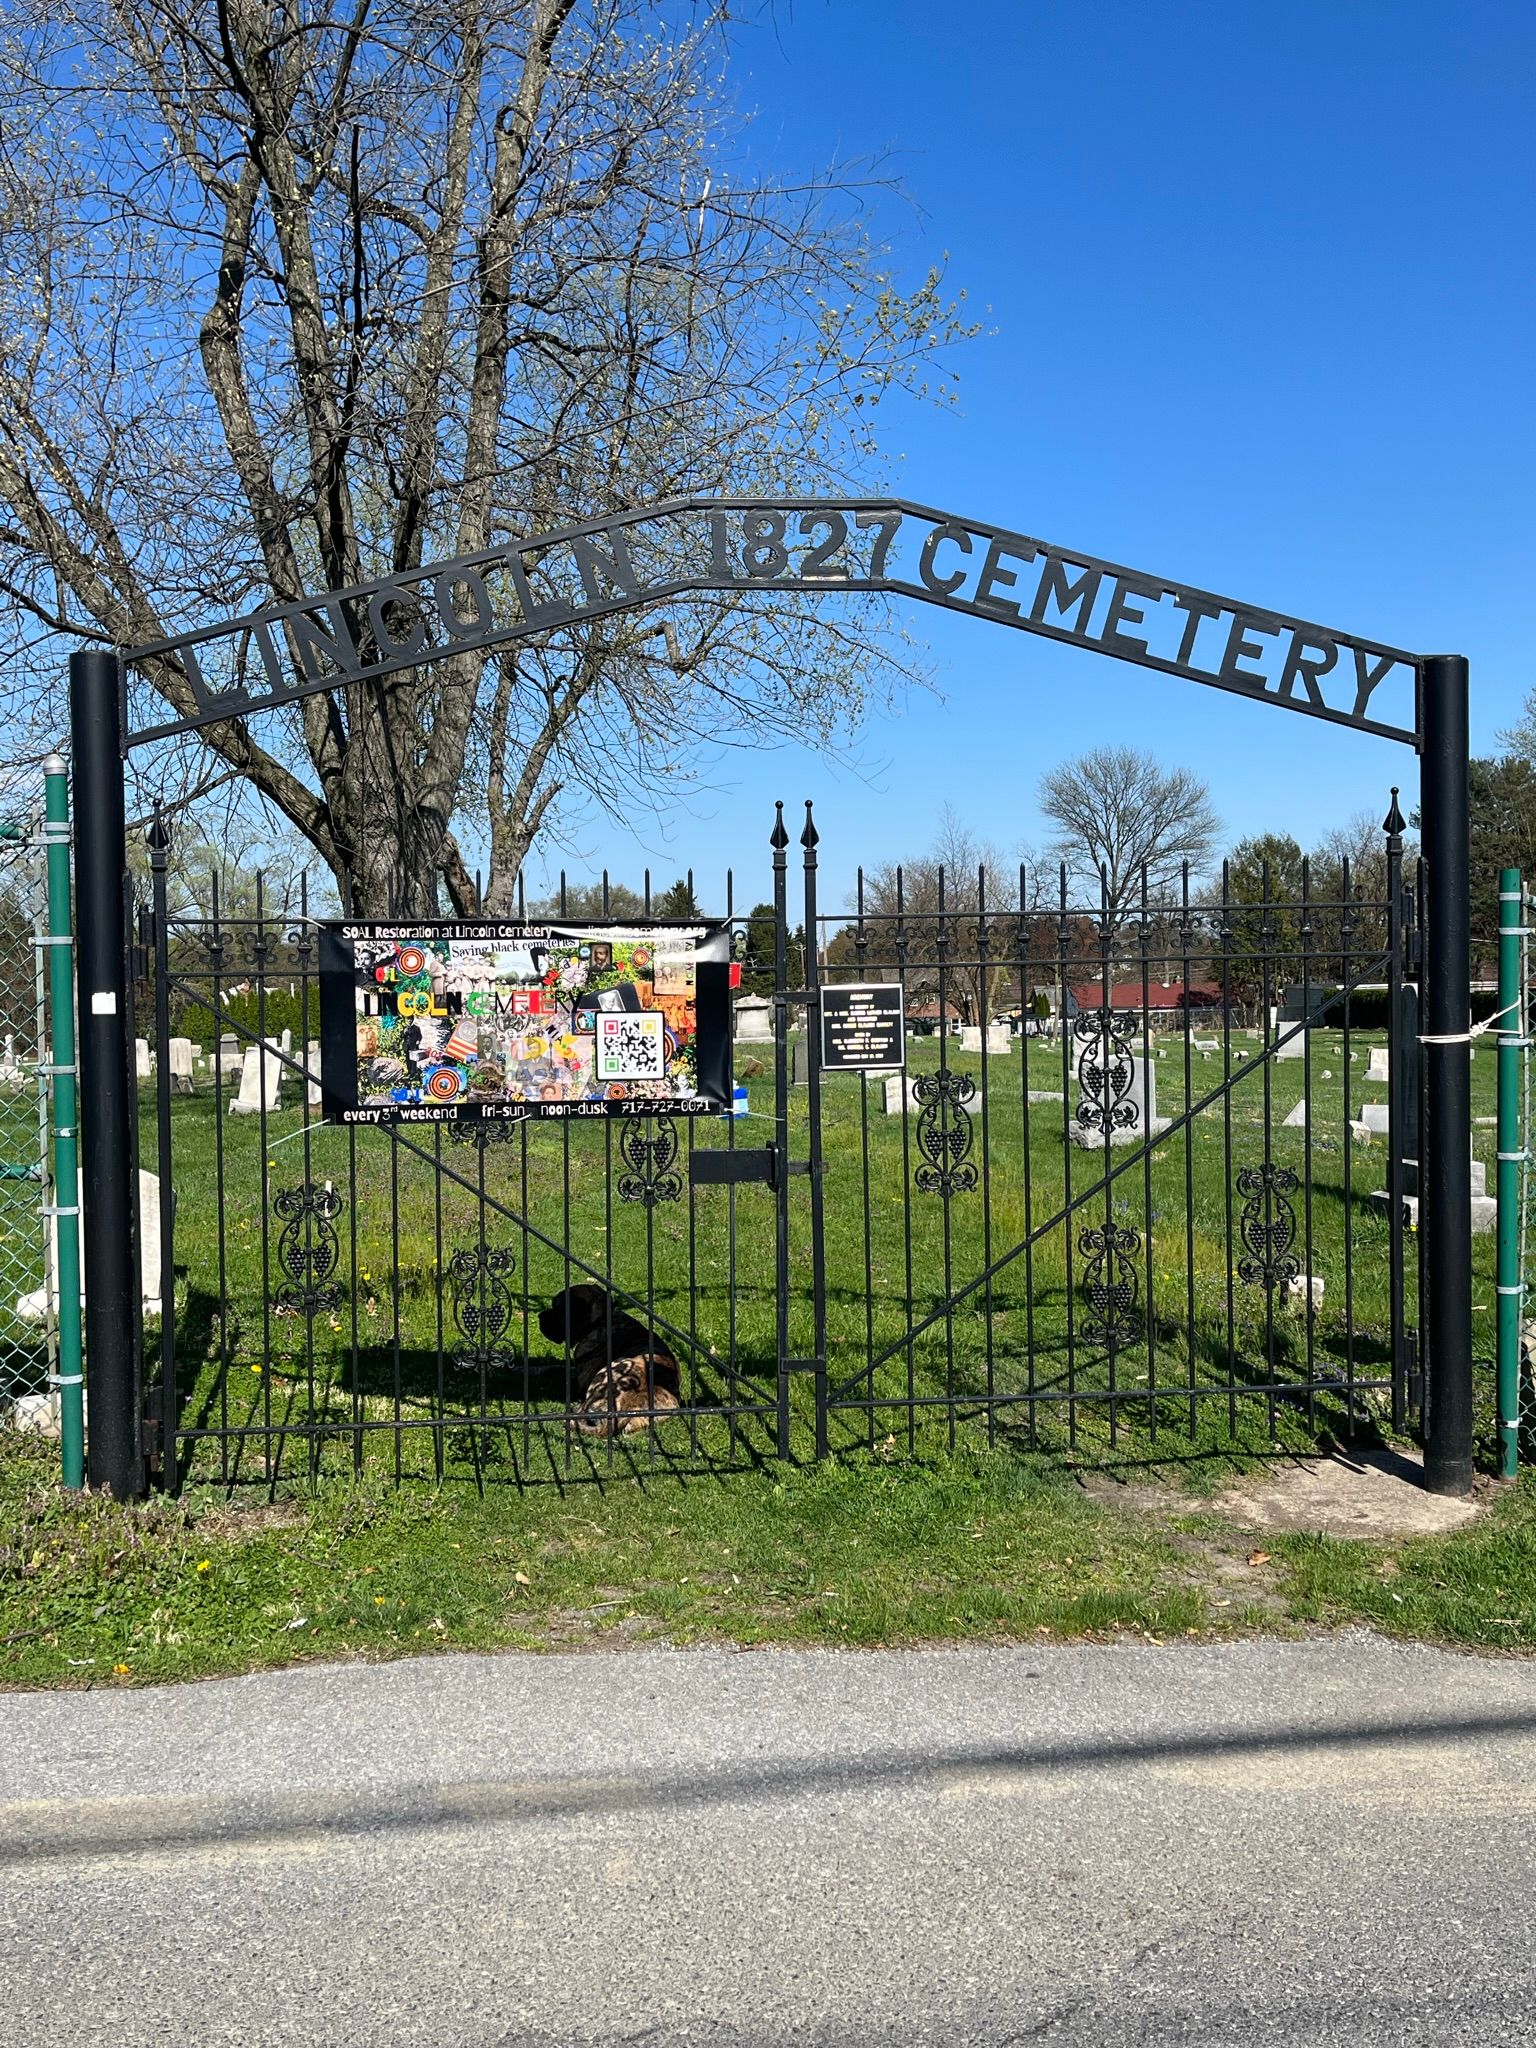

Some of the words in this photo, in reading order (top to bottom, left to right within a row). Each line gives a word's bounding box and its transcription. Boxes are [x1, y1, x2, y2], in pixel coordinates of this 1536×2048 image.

[178, 524, 641, 714] LINCOLN
[705, 505, 904, 581] 1827
[918, 523, 1396, 718] CEMETERY
[375, 925, 440, 939] Restoration
[441, 926, 453, 938] at
[455, 925, 496, 938] Lincoln
[498, 925, 552, 940] Cemetery
[451, 944, 489, 958] Saving
[491, 940, 519, 953] black
[522, 938, 576, 951] cemeteries
[466, 989, 583, 1017] CEMETERY
[343, 1109, 381, 1123] every
[382, 1105, 398, 1121] 3rd
[400, 1106, 458, 1120] weekend
[481, 1104, 526, 1118] fri-sun
[540, 1102, 608, 1116] noon-dusk
[621, 1099, 711, 1114] 717-727-0071
